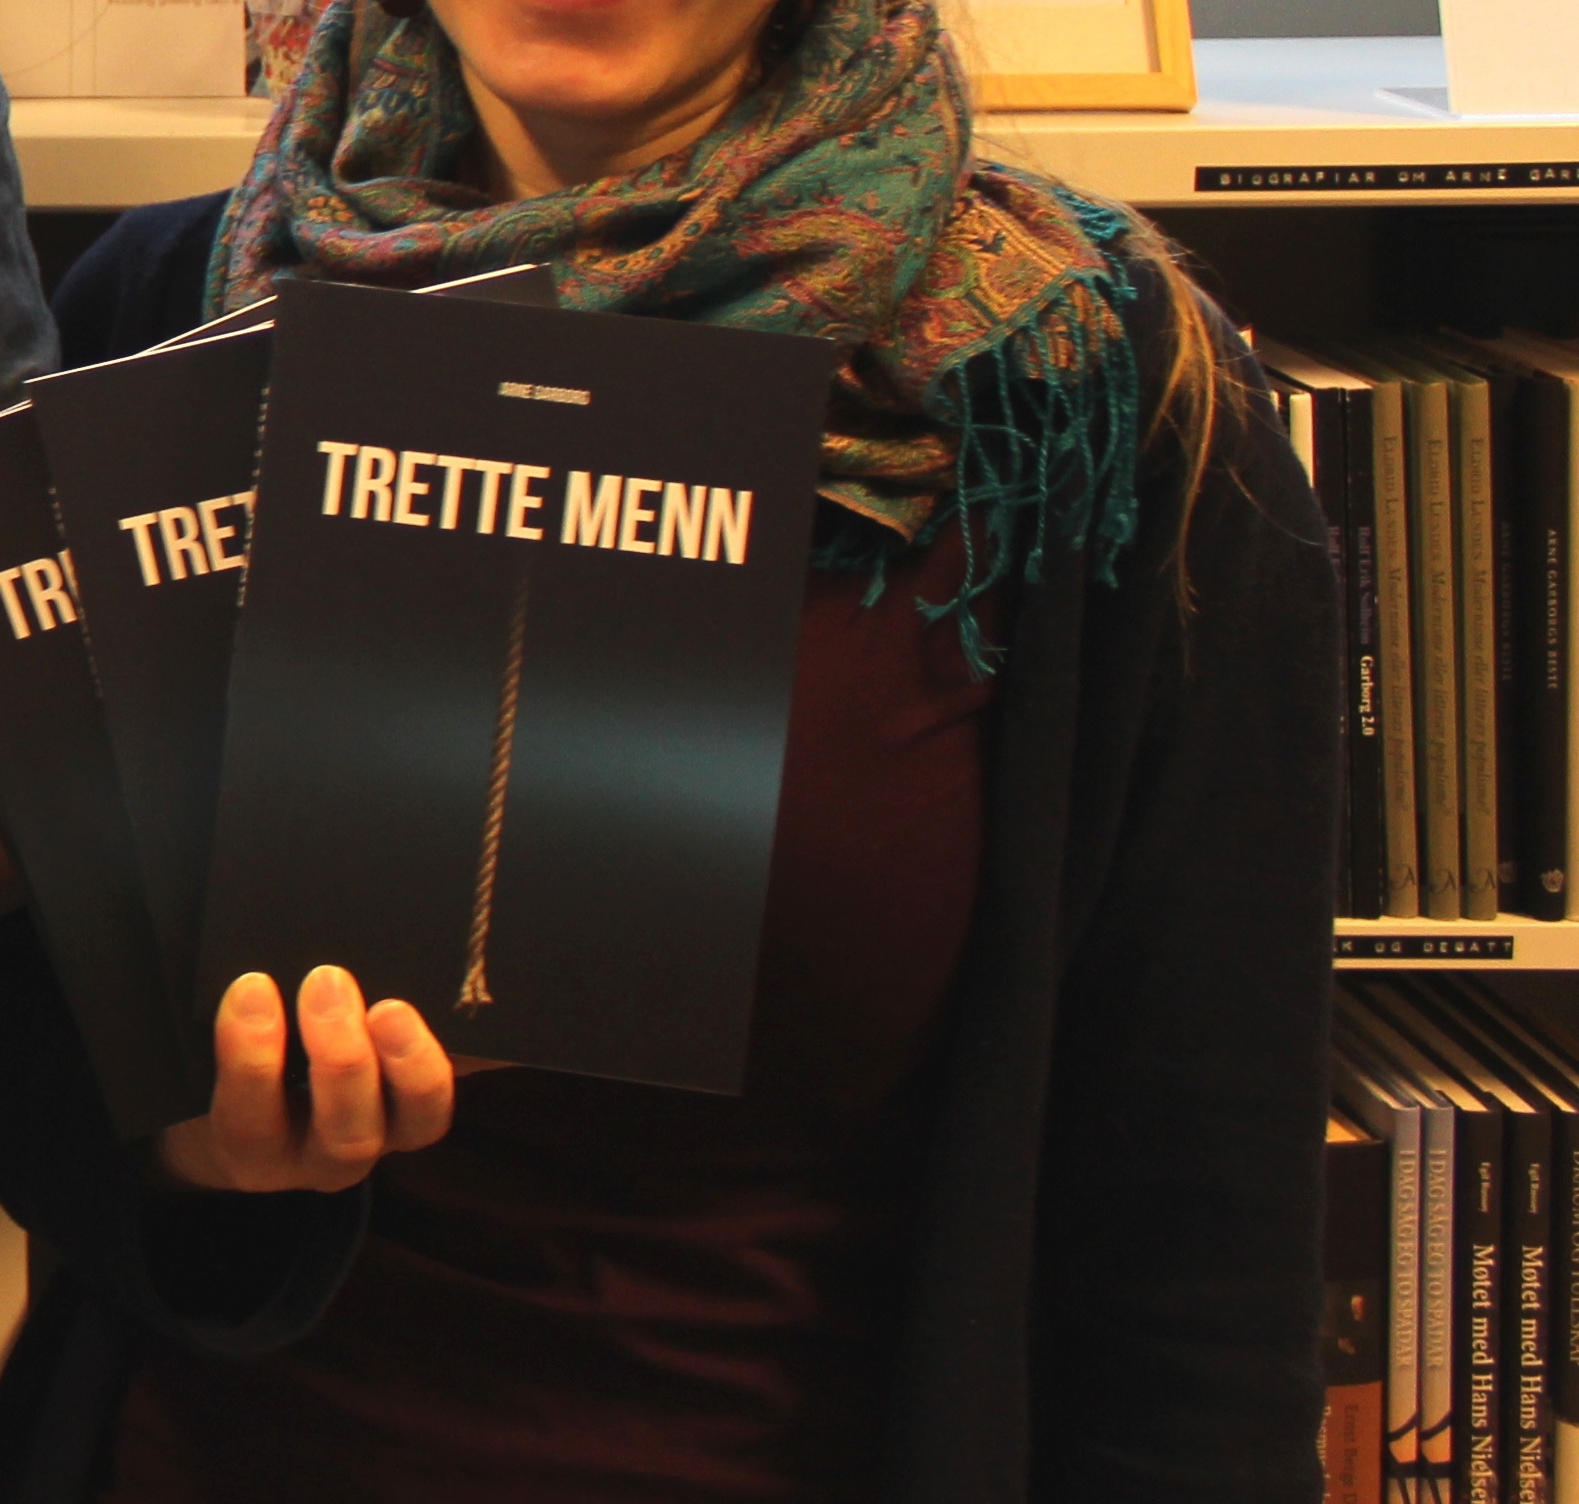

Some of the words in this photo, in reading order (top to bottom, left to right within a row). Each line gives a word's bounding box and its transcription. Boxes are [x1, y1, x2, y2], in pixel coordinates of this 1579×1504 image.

[1398, 170, 1426, 183] OM
[1445, 168, 1508, 183] ARNE
[317, 439, 551, 542] TRETTE
[559, 470, 753, 566] MENN
[1358, 655, 1376, 714] Garborg
[1362, 715, 1376, 736] 2.0
[1375, 942, 1401, 953] OG
[1423, 942, 1512, 953] DEBATT
[1472, 1245, 1494, 1310] Møtet
[1522, 1245, 1542, 1311] Møtet
[1472, 1317, 1493, 1366] med
[1521, 1318, 1542, 1369] med
[1471, 1373, 1493, 1428] Hans
[1520, 1374, 1542, 1430] Hans
